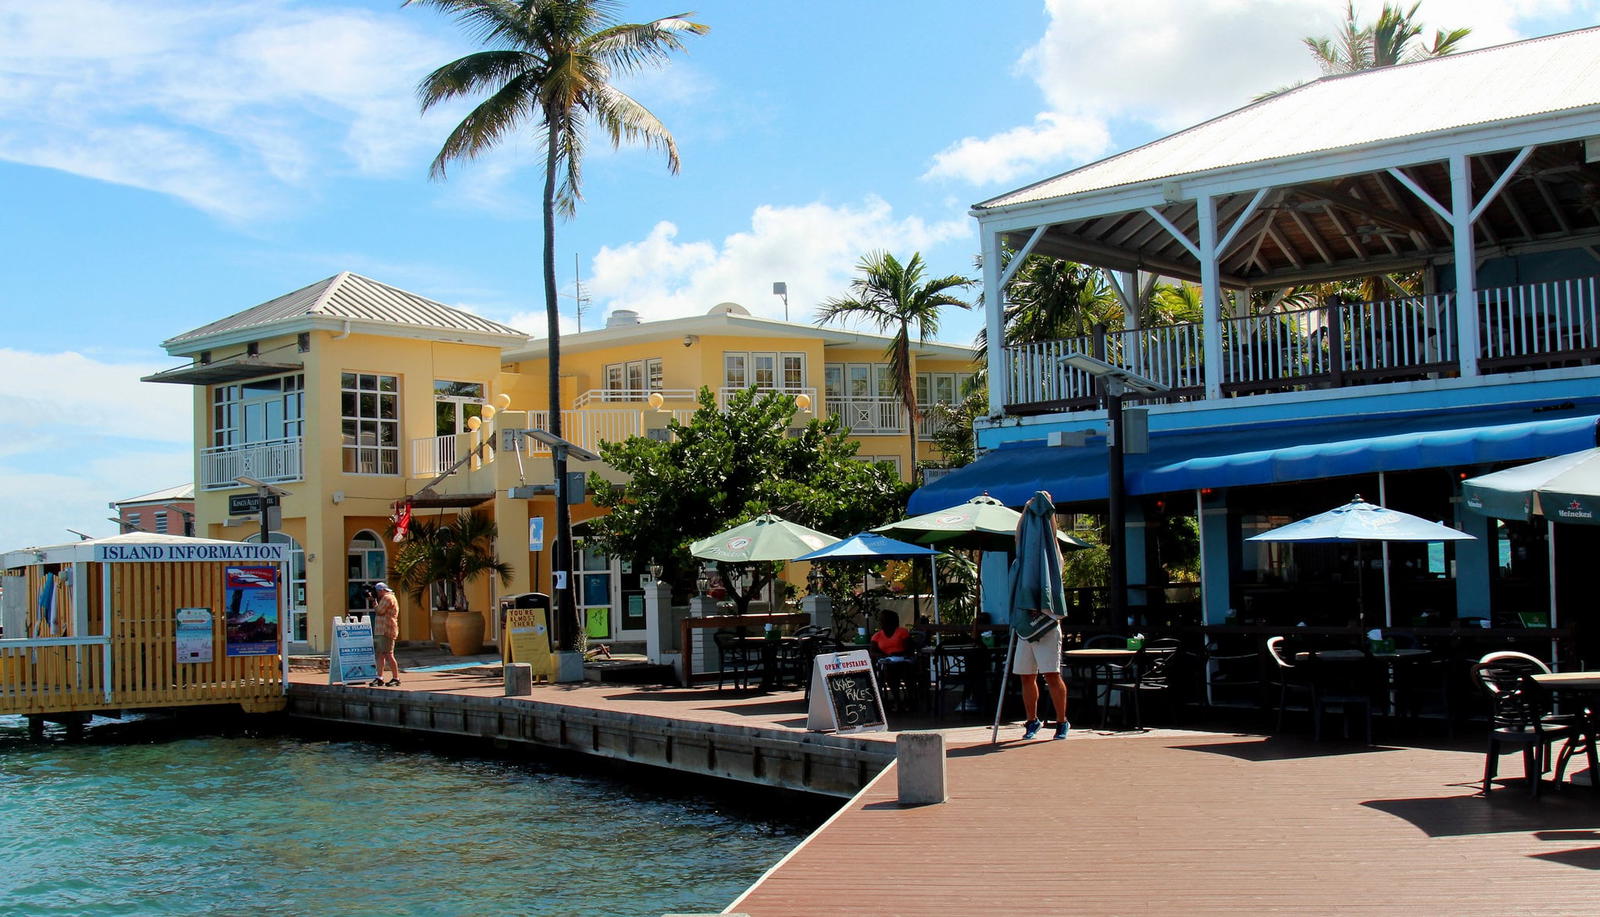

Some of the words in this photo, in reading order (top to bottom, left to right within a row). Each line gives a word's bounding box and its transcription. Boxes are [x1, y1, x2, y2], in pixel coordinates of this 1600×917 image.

[1558, 510, 1592, 518] Heineken
[103, 546, 164, 560] ISLAND
[169, 546, 282, 559] INFORMATION
[824, 662, 840, 670] OPEN
[841, 660, 868, 668] UPSTAIRS
[832, 677, 856, 691] CRAB
[845, 688, 874, 702] RACES
